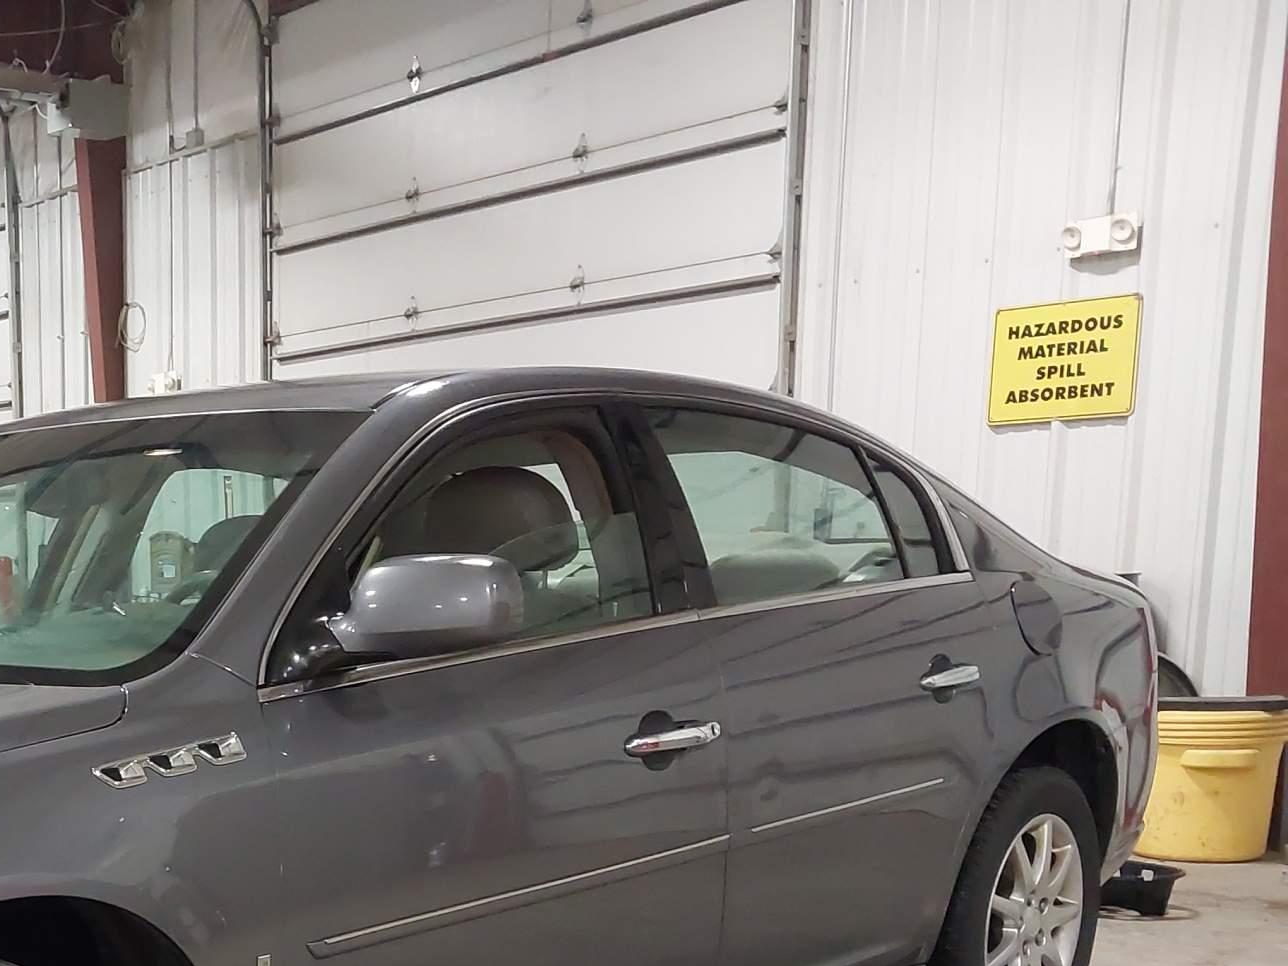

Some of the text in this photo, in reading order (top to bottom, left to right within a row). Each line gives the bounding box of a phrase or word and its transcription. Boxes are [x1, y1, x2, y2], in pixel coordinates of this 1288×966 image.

[1008, 314, 1123, 340] HAZARDOUS
[1017, 338, 1109, 361] MATERIAL
[1036, 363, 1086, 380] SPILL
[1005, 382, 1115, 404] ABSORBENT
